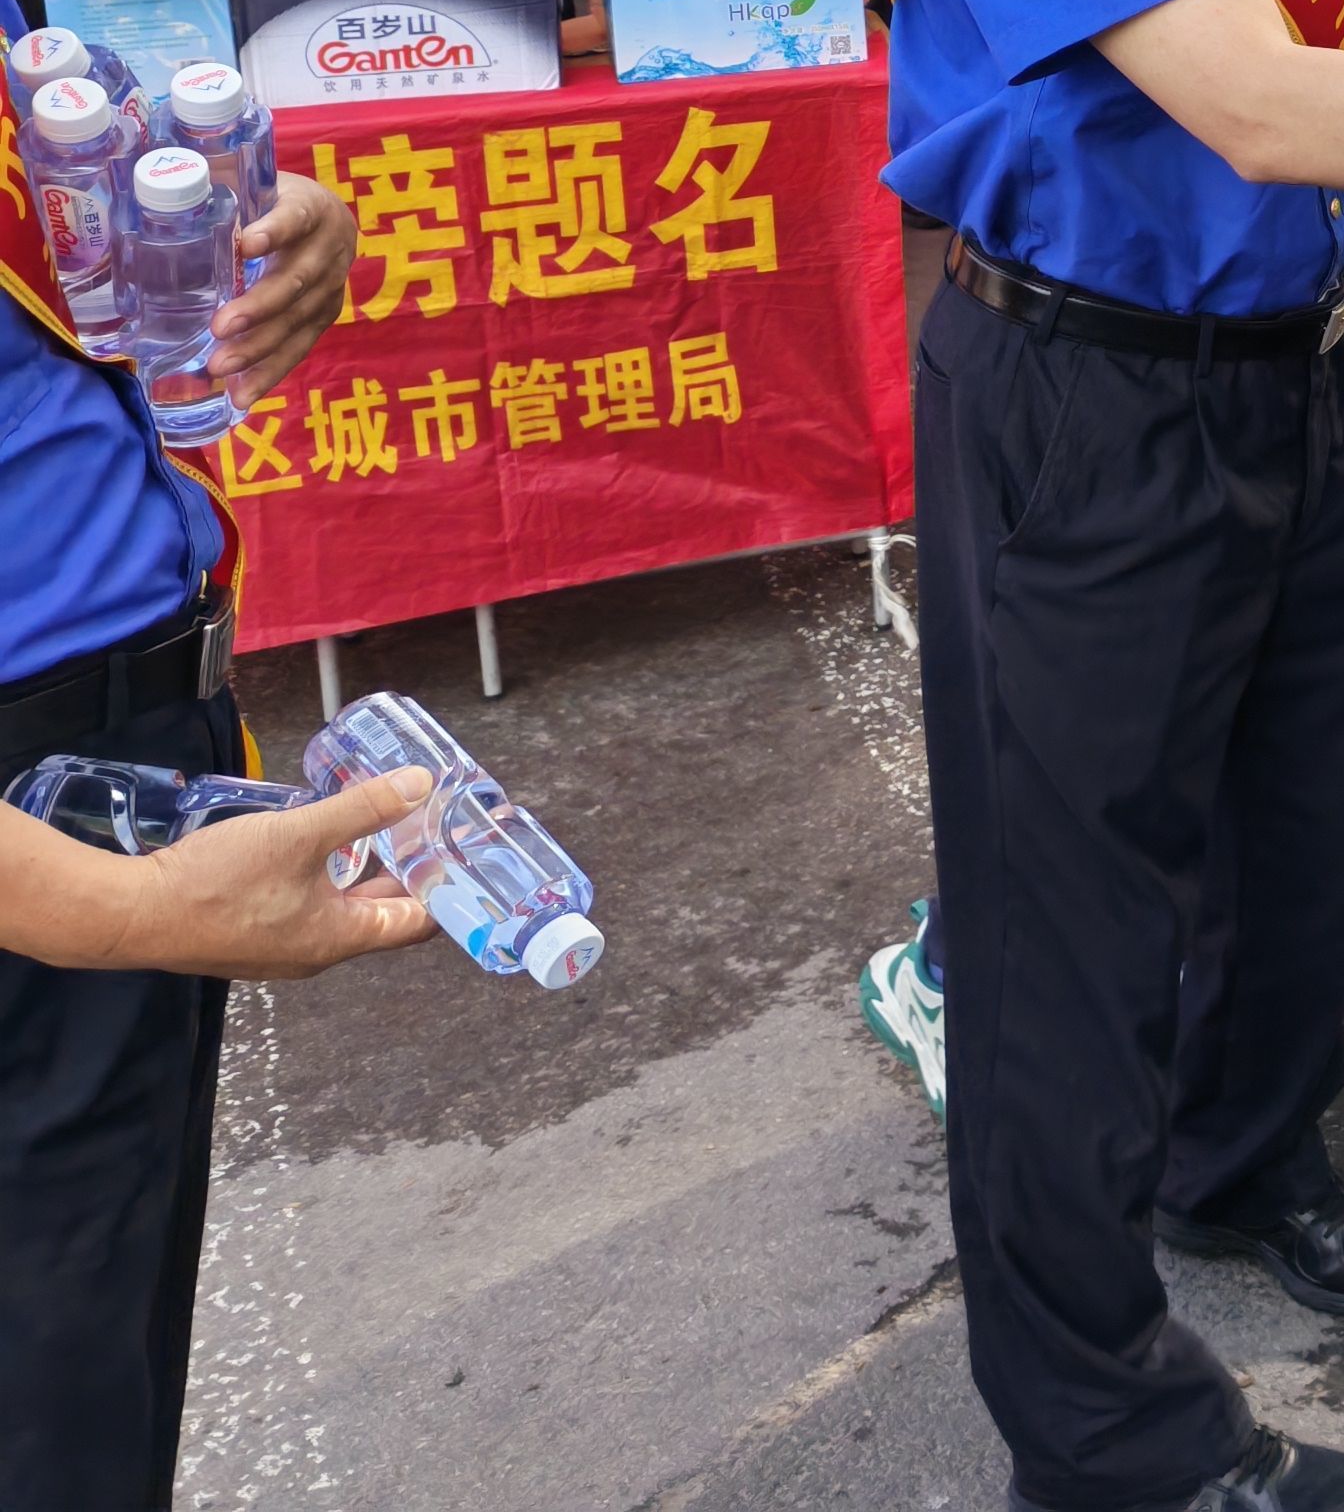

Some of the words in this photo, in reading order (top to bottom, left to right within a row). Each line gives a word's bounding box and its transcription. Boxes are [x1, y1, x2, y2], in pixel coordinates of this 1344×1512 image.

[335, 13, 437, 41] 百岁山
[323, 69, 490, 93] 饮用天然矿泉水
[83, 212, 104, 248] 百岁山
[312, 107, 778, 324] 榜题名
[218, 332, 742, 498] 区城市管理局
